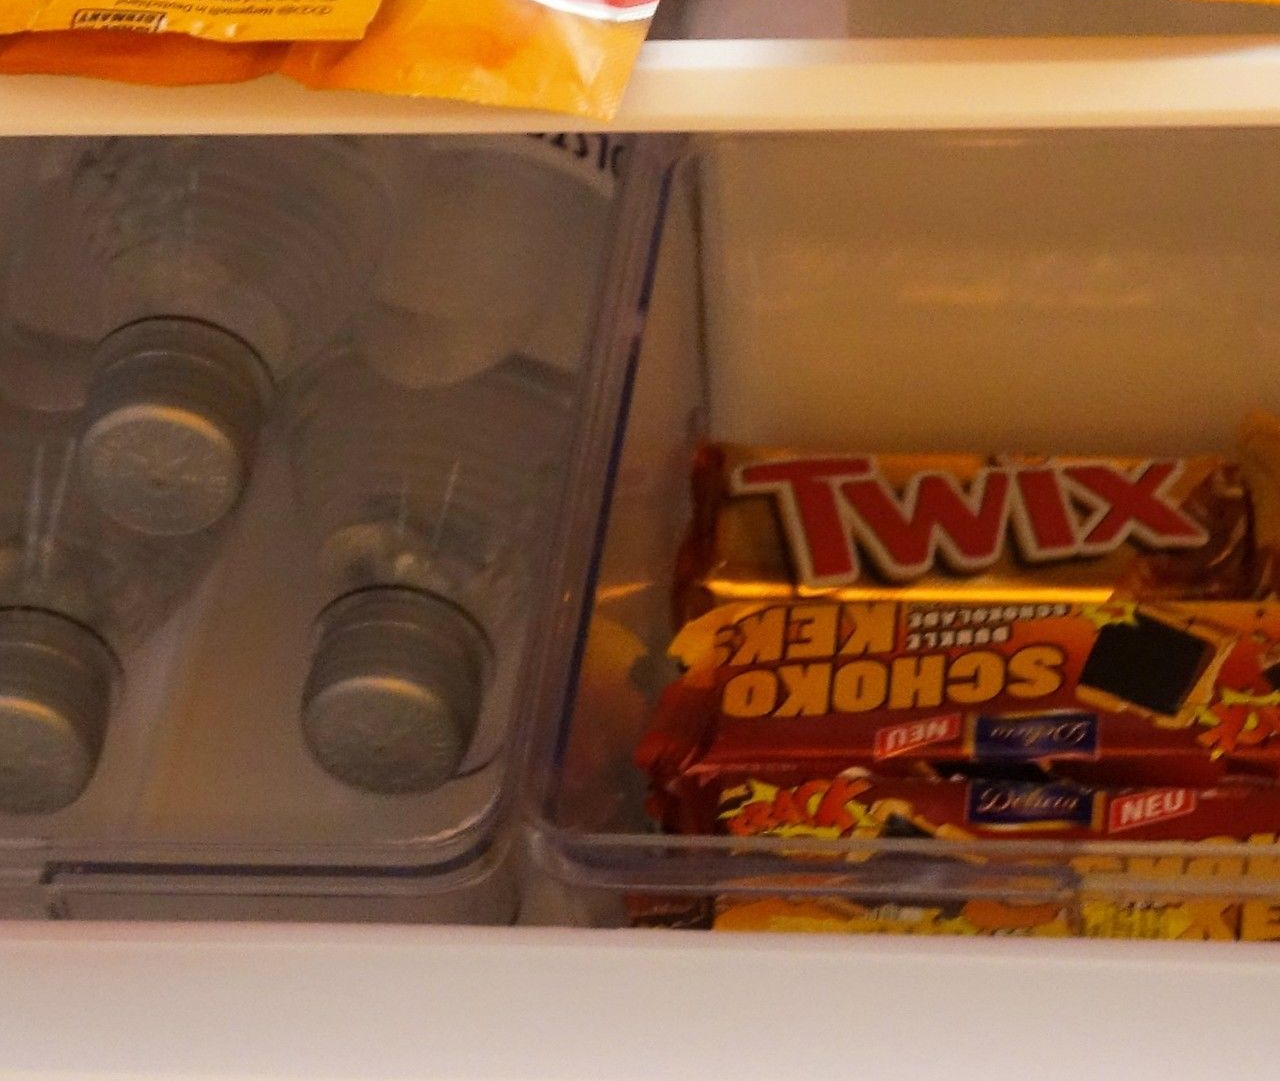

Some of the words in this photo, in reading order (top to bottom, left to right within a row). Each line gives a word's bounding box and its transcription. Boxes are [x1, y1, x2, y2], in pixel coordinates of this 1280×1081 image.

[721, 644, 1064, 719] SCHOKO
[886, 719, 949, 751] NEU
[1120, 789, 1186, 825] NEU
